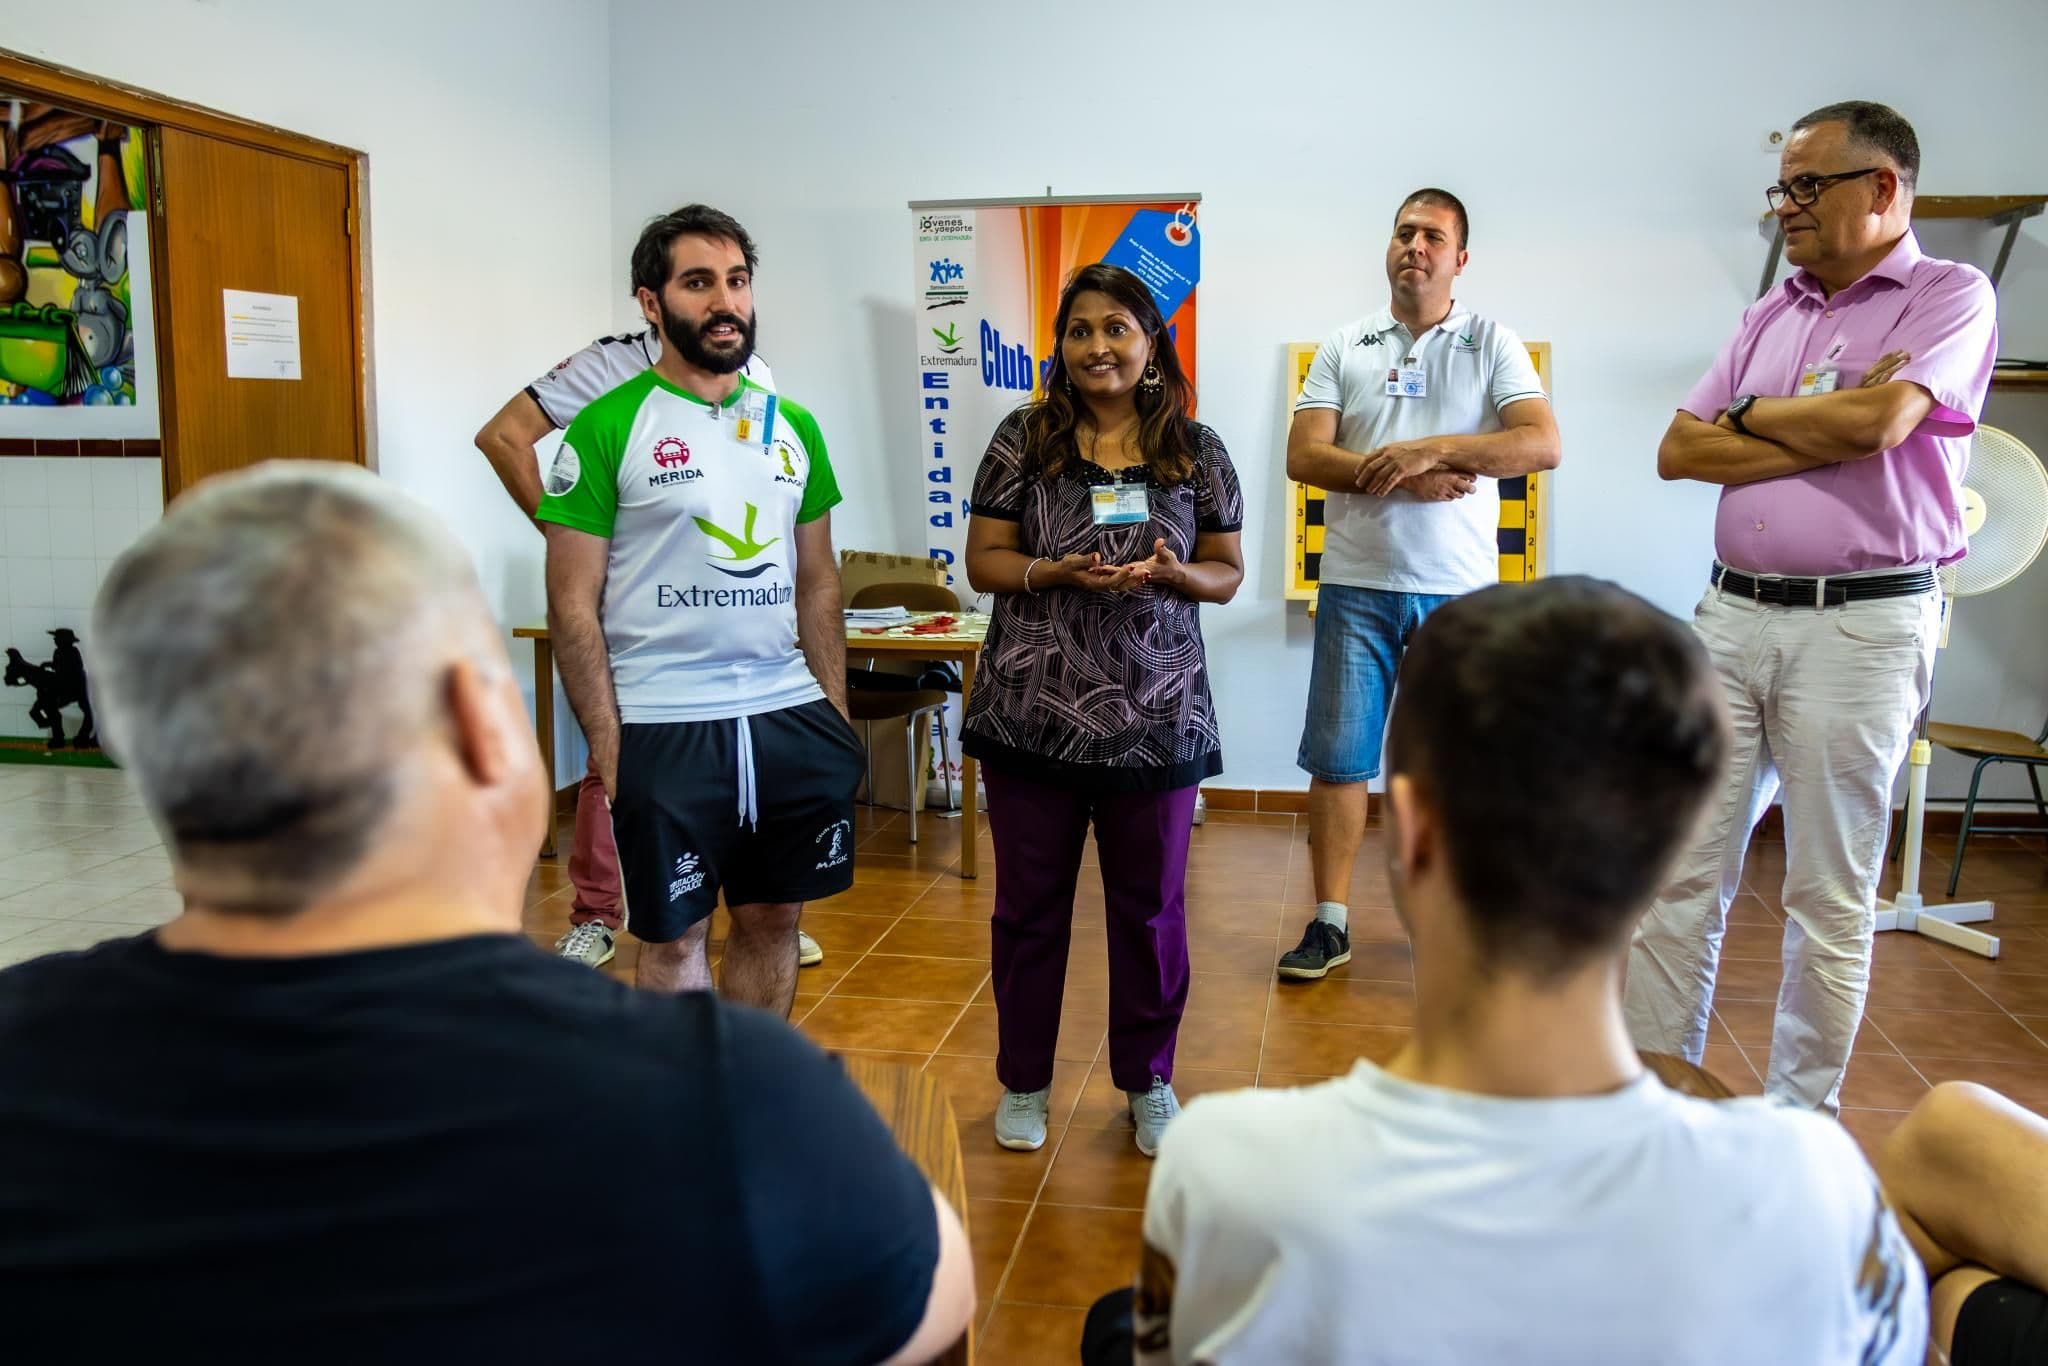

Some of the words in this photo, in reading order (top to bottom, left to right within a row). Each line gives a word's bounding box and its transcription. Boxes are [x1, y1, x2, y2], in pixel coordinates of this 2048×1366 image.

[980, 319, 1033, 391] Club
[921, 355, 977, 366] Extremadura
[922, 372, 953, 528] Entidad
[1529, 483, 1536, 492] 4
[1297, 508, 1304, 517] 3
[1529, 510, 1536, 519] 3
[1297, 535, 1304, 544] 2
[1528, 537, 1535, 546] 2
[1297, 562, 1303, 570] 1
[1528, 564, 1533, 573] 1
[815, 853, 848, 870] MAGIC
